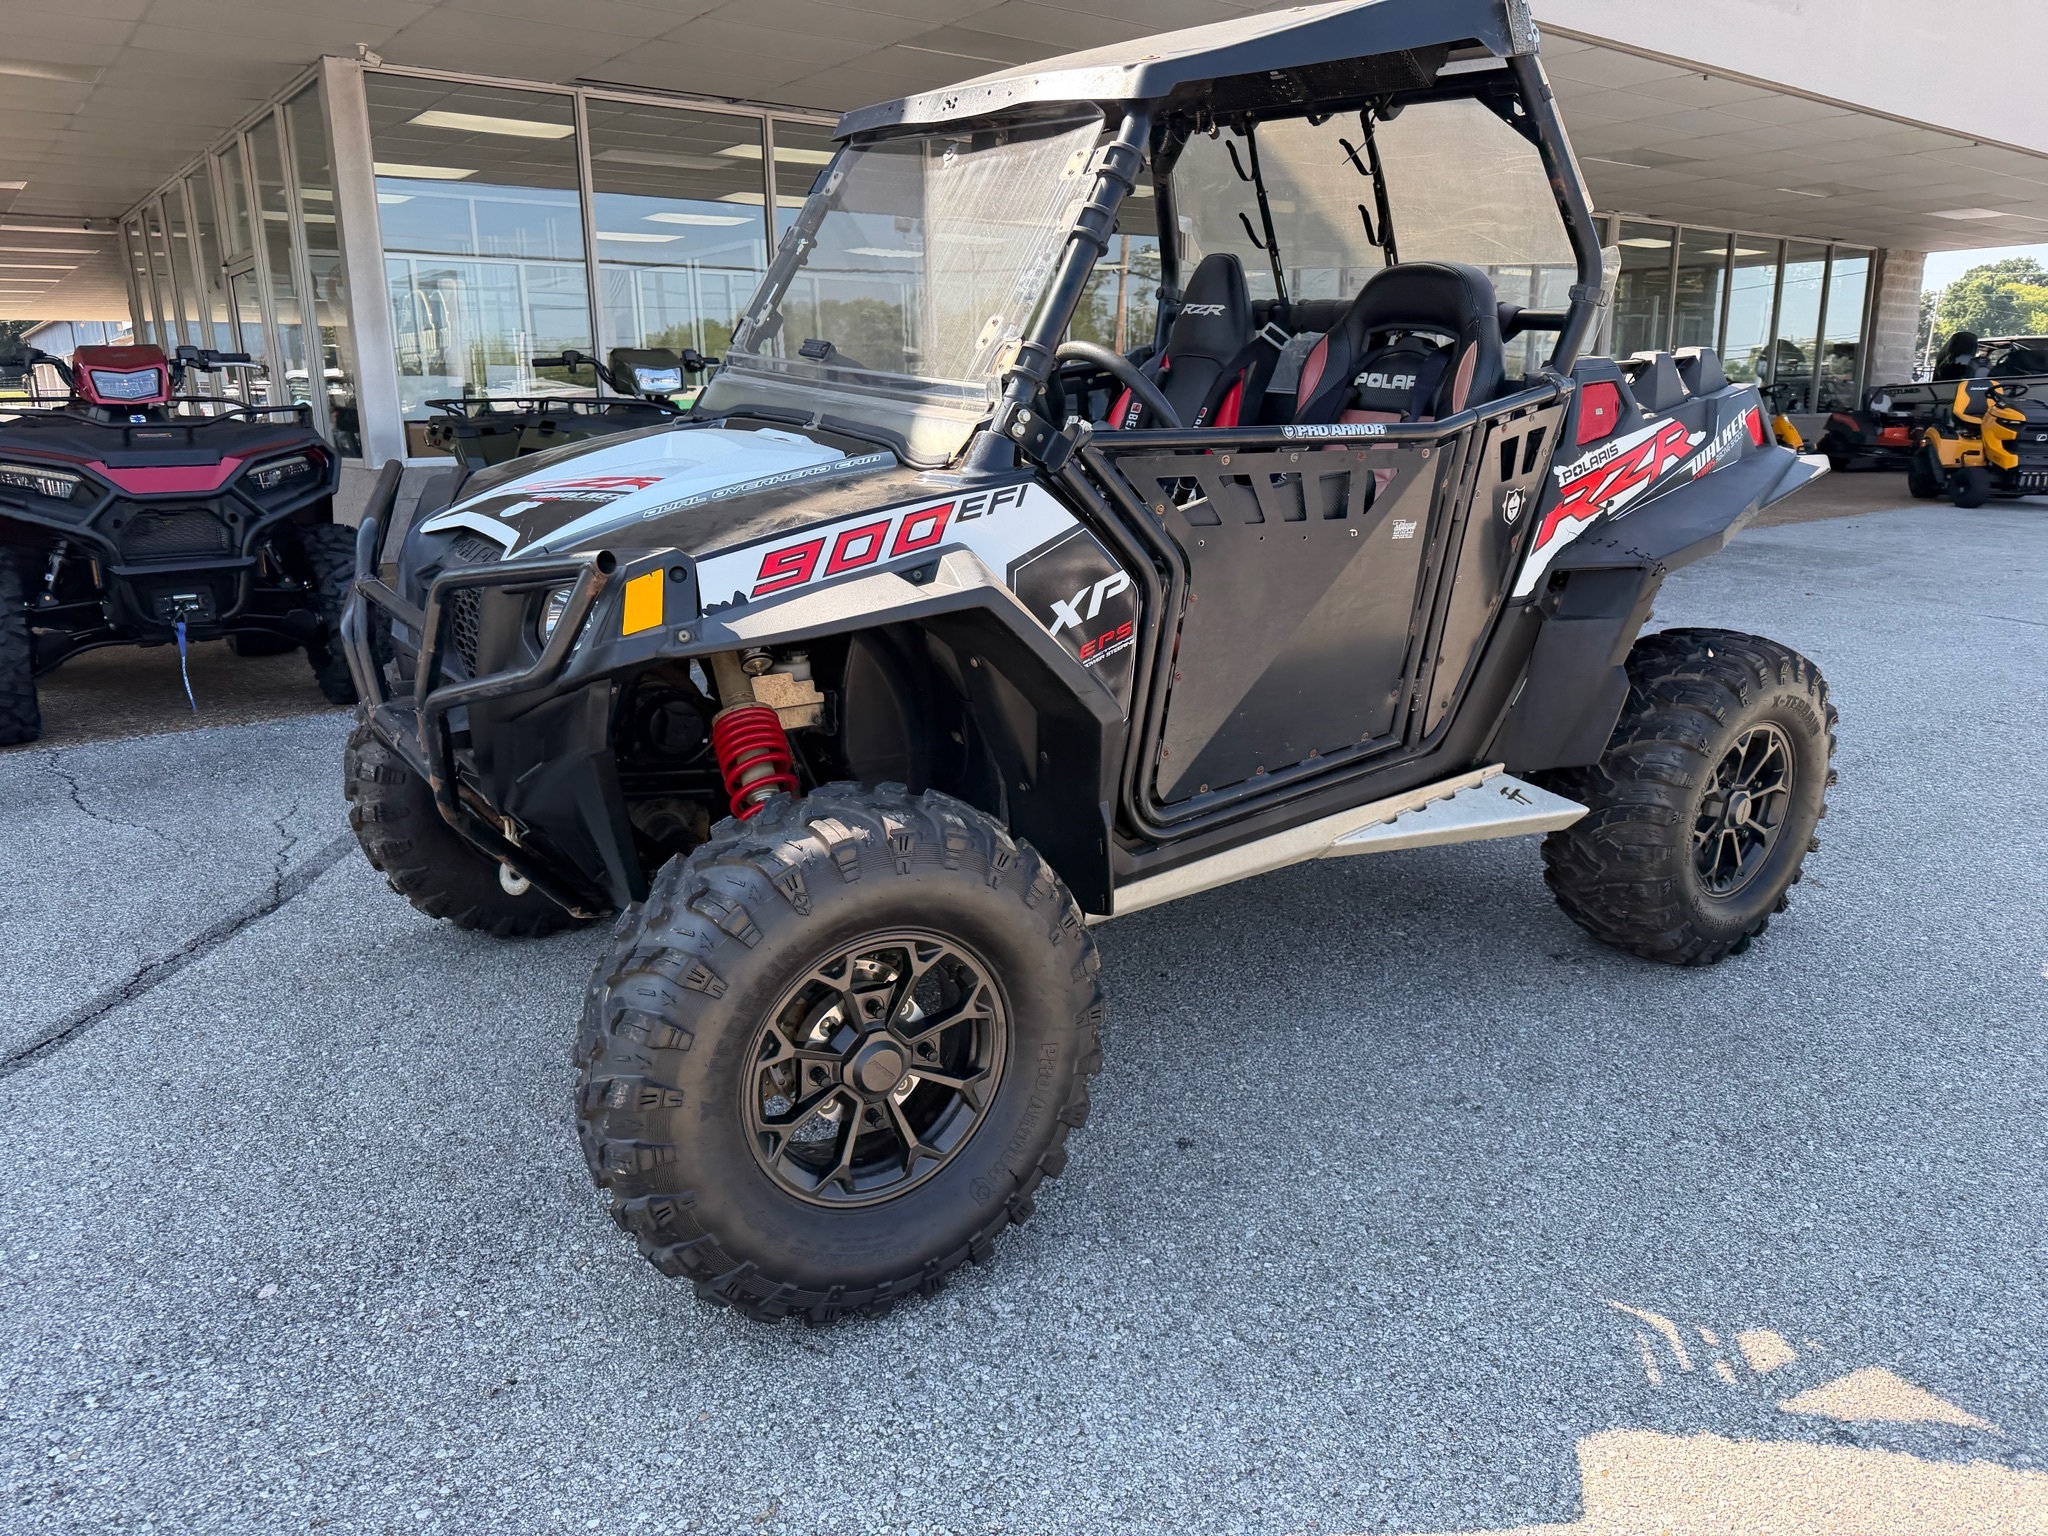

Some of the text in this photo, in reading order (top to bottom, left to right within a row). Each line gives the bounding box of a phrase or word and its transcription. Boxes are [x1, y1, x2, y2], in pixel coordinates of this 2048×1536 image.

[1181, 303, 1226, 316] RZR
[1296, 423, 1386, 437] PRO ARMOR
[1691, 408, 1747, 476] WALKER
[643, 454, 881, 519] DUAL OVERHEAD CAM
[1531, 420, 1695, 556] RZR
[1563, 444, 1619, 483] POLARIS
[750, 484, 1028, 598] 900 EFI
[1049, 569, 1131, 637] XP
[1080, 620, 1132, 659] EPS
[1035, 1042, 1059, 1092] PRO
